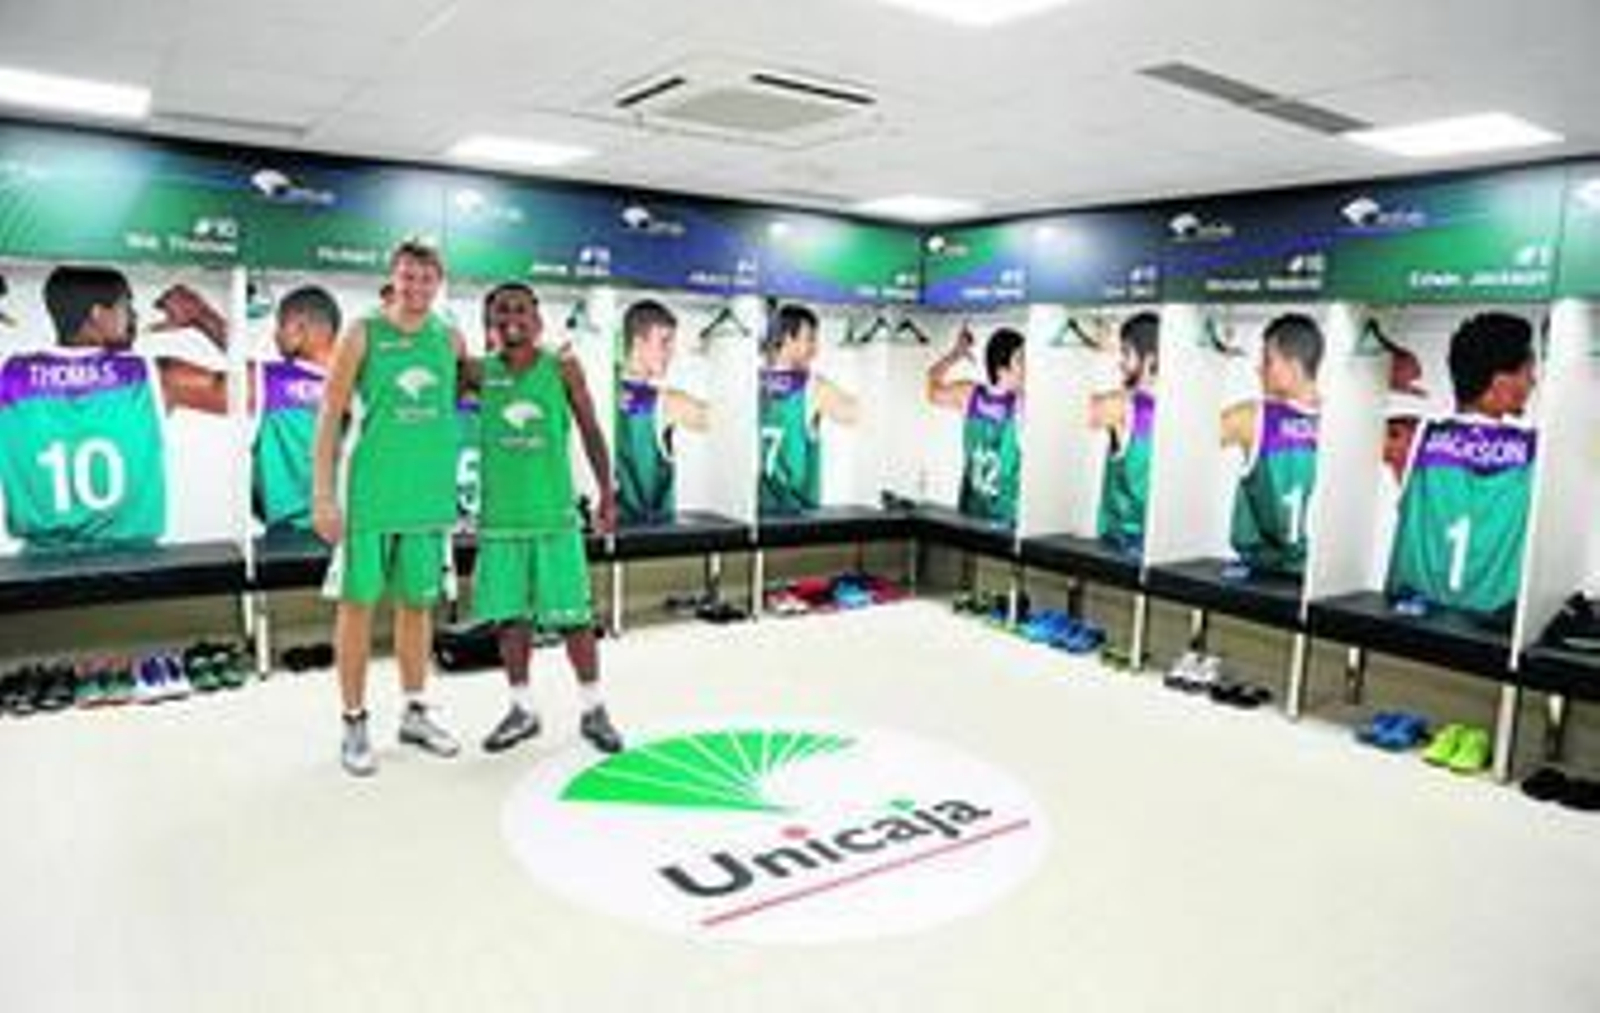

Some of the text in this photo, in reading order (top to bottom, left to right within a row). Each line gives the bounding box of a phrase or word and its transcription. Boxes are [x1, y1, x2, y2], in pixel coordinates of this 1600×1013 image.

[29, 362, 119, 387] THOMAS
[35, 437, 126, 514] 10
[1445, 515, 1473, 590] 1
[658, 796, 993, 897] Unicaja
